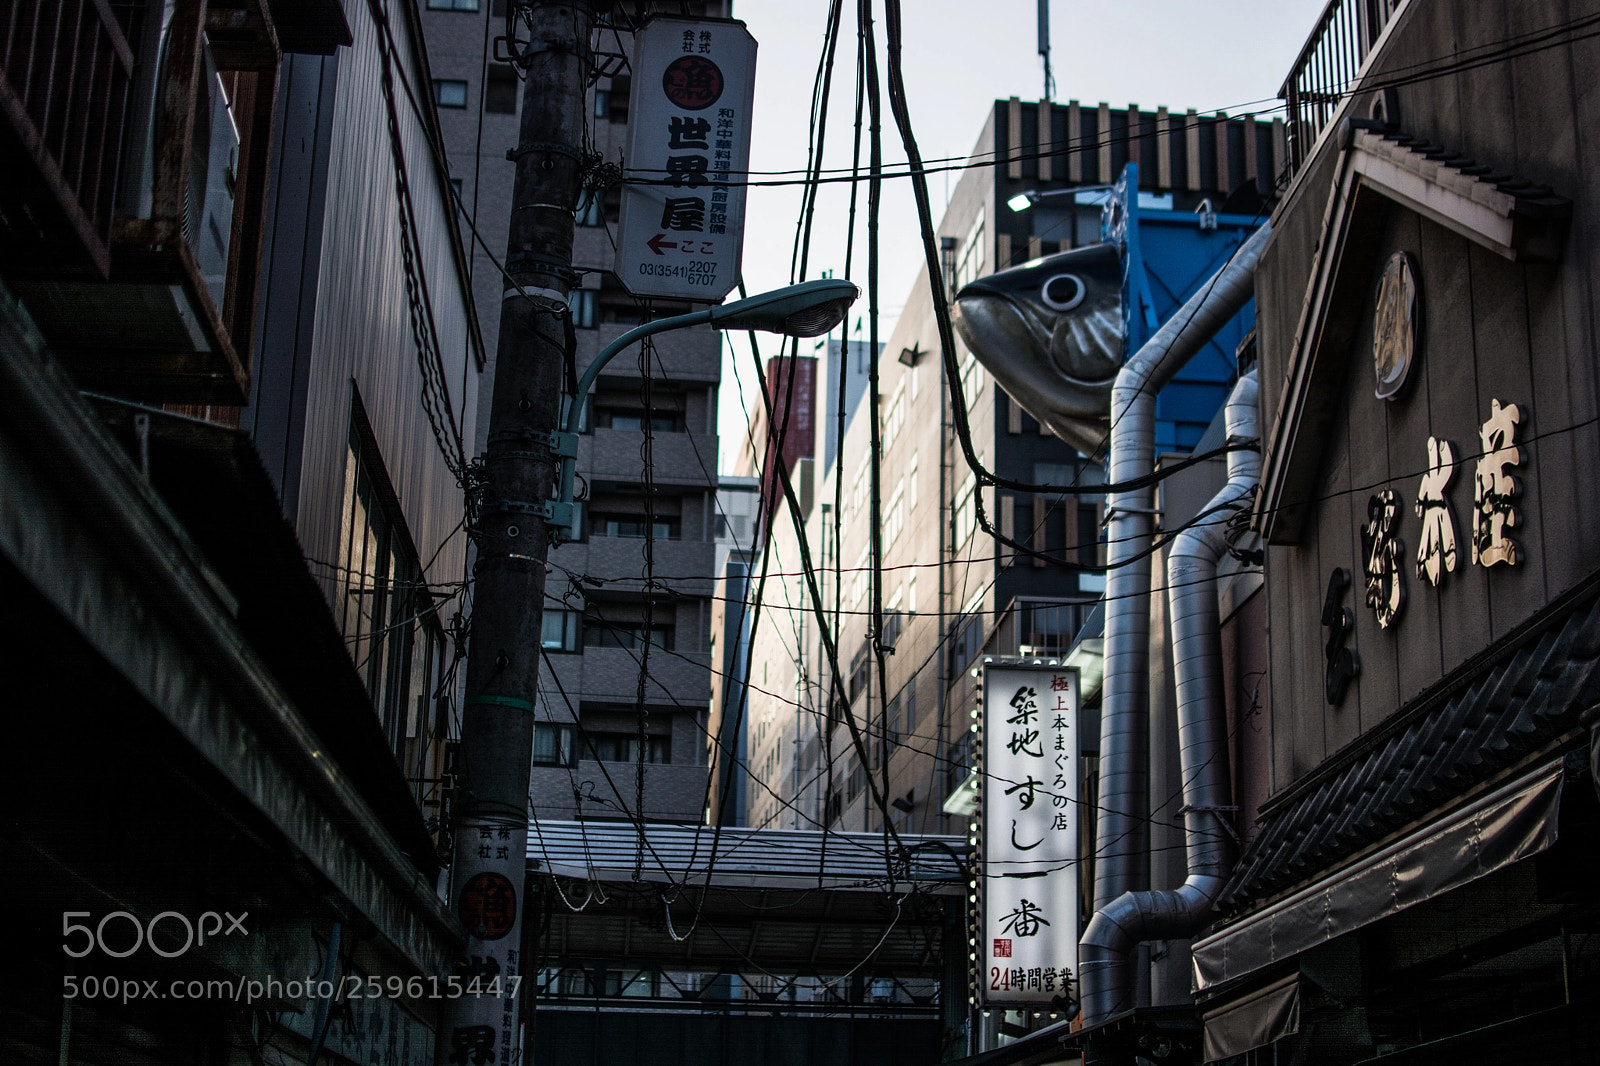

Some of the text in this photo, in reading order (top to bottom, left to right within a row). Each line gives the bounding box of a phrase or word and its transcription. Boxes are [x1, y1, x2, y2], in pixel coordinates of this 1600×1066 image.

[661, 116, 712, 232] 世界屋
[681, 240, 714, 255] ここ
[687, 273, 717, 286] 6707
[688, 260, 718, 275] 2207
[1050, 674, 1070, 831] 極上本まぐろの店
[998, 686, 1051, 938] 築地すし一番
[990, 966, 1075, 993] 24時間営業
